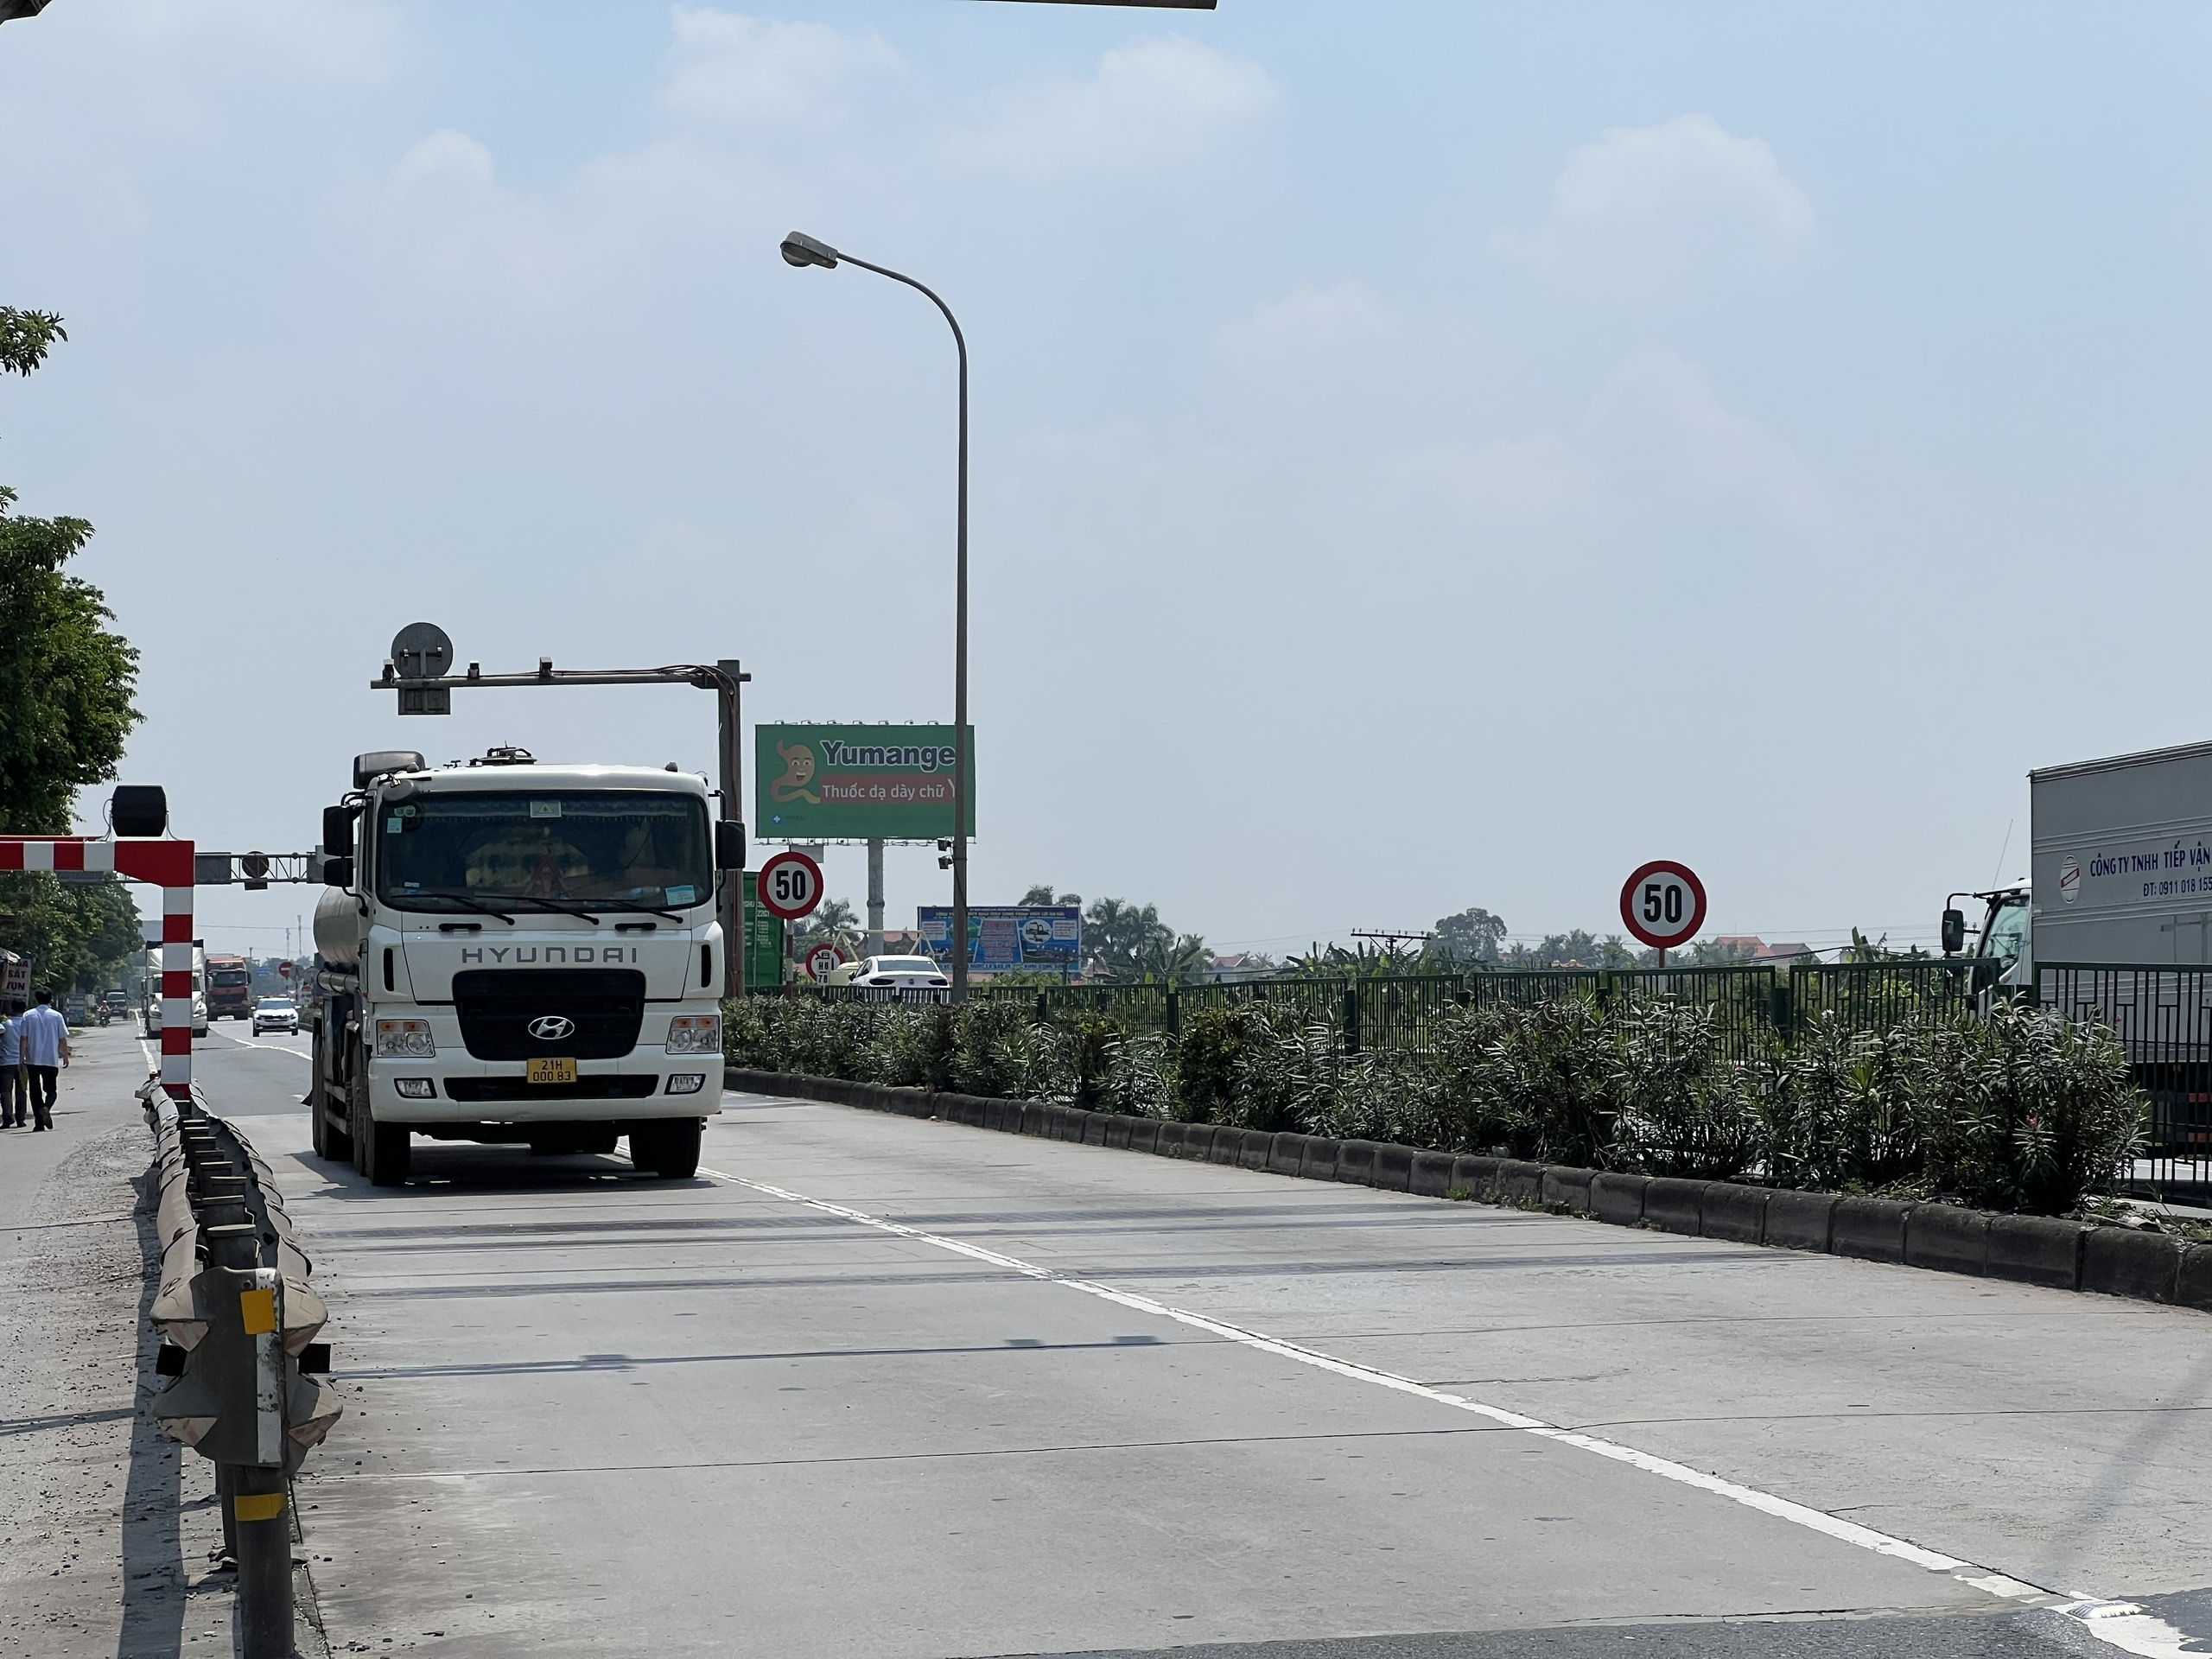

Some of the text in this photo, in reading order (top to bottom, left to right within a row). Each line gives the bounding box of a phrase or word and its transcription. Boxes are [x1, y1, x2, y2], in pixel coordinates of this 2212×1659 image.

[823, 782, 865, 798] Thuốc
[869, 785, 887, 800] dạ
[891, 785, 915, 800] dày
[919, 785, 944, 798] chữ
[2090, 840, 2210, 877] CÔNG TY TNHH TIẾP VẬN
[776, 869, 806, 900] 50
[2143, 881, 2157, 897] ĐT:
[2159, 880, 2178, 895] 0911
[2181, 879, 2196, 893] 018
[1643, 884, 1682, 924] 50
[462, 947, 637, 963] HYUNDAI
[541, 1060, 562, 1071] 21H
[532, 1071, 571, 1082] 000.83
